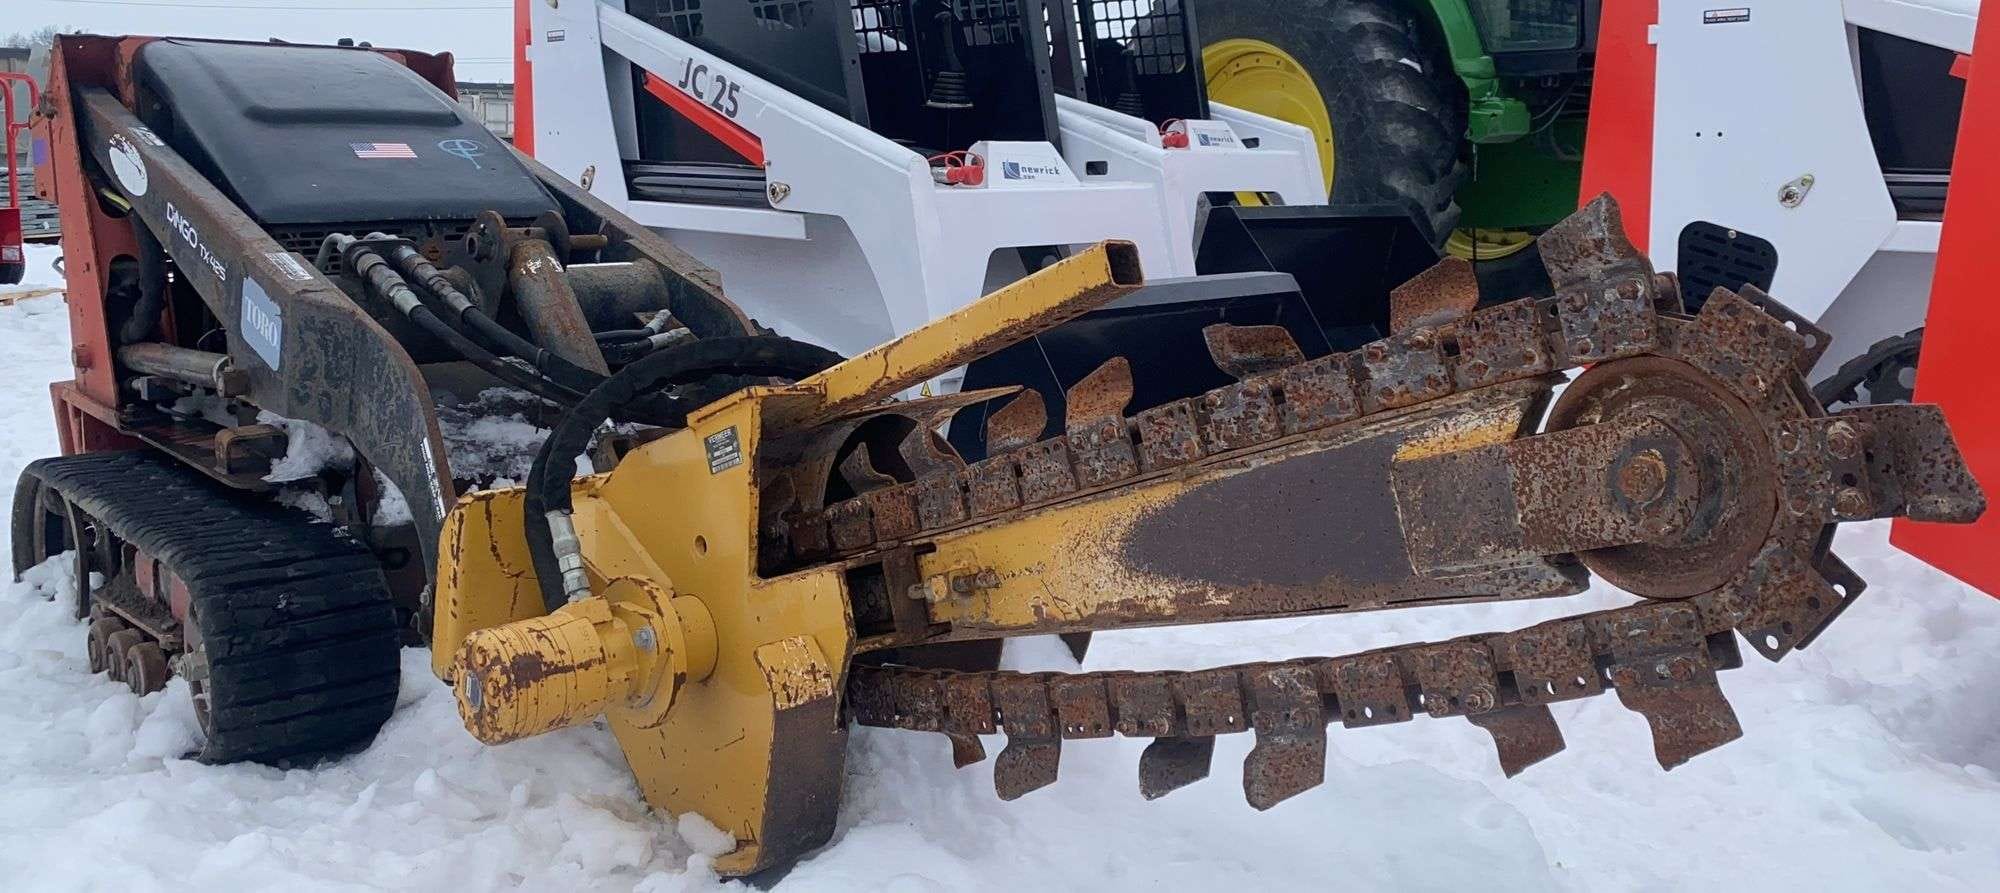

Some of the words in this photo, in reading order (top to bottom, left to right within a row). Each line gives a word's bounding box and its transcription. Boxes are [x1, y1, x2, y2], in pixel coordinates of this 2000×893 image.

[678, 57, 708, 100] JC
[711, 74, 741, 119] 25
[1021, 166, 1060, 175] newrick
[166, 201, 198, 249] DINGO
[245, 295, 279, 346] TORO
